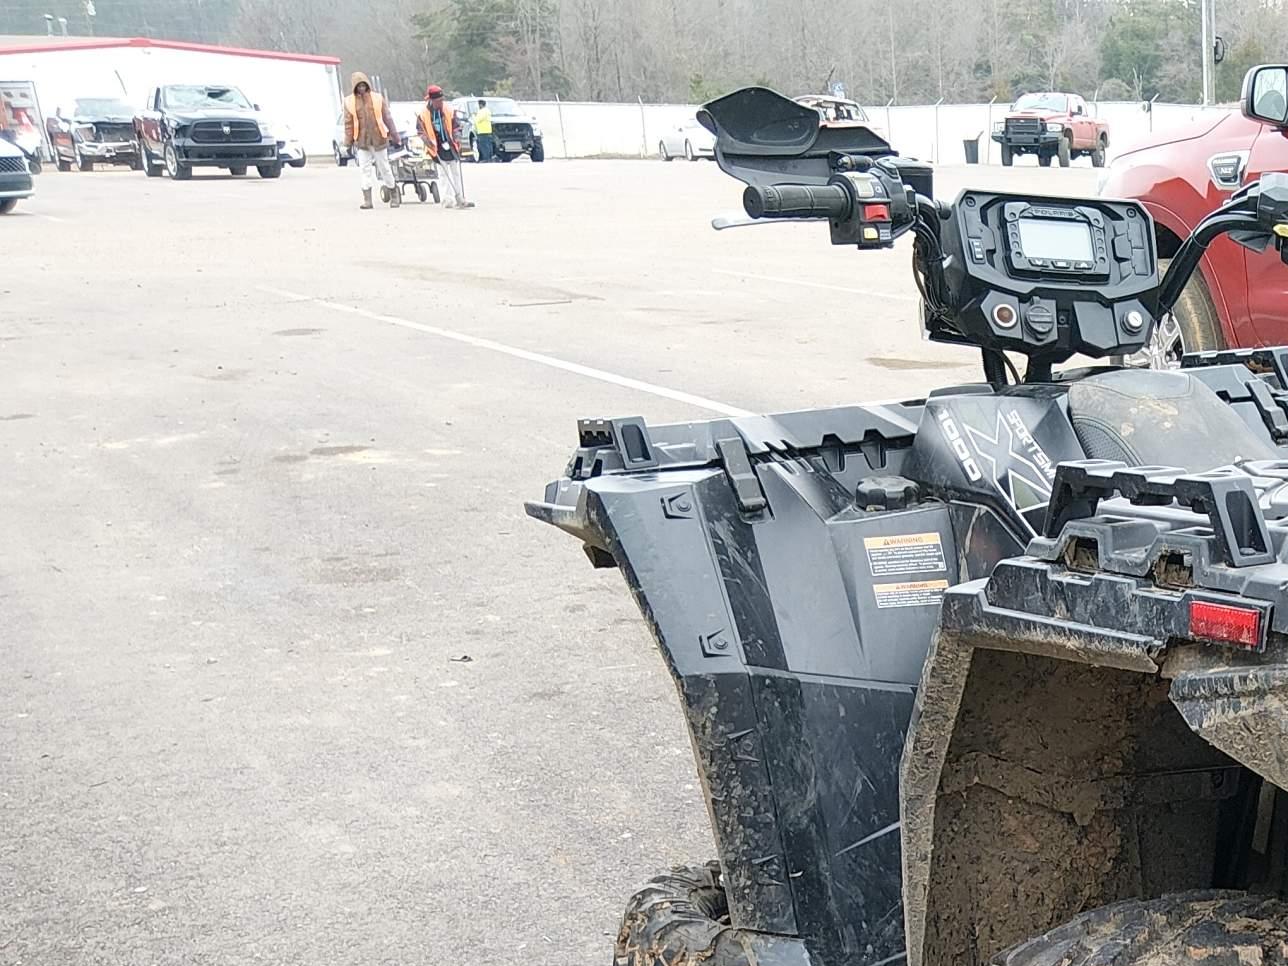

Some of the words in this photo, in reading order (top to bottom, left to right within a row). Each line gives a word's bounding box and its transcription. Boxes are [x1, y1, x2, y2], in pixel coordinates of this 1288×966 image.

[1034, 209, 1074, 217] POLARIS
[938, 409, 981, 481] 1000
[890, 537, 923, 545] WARNING
